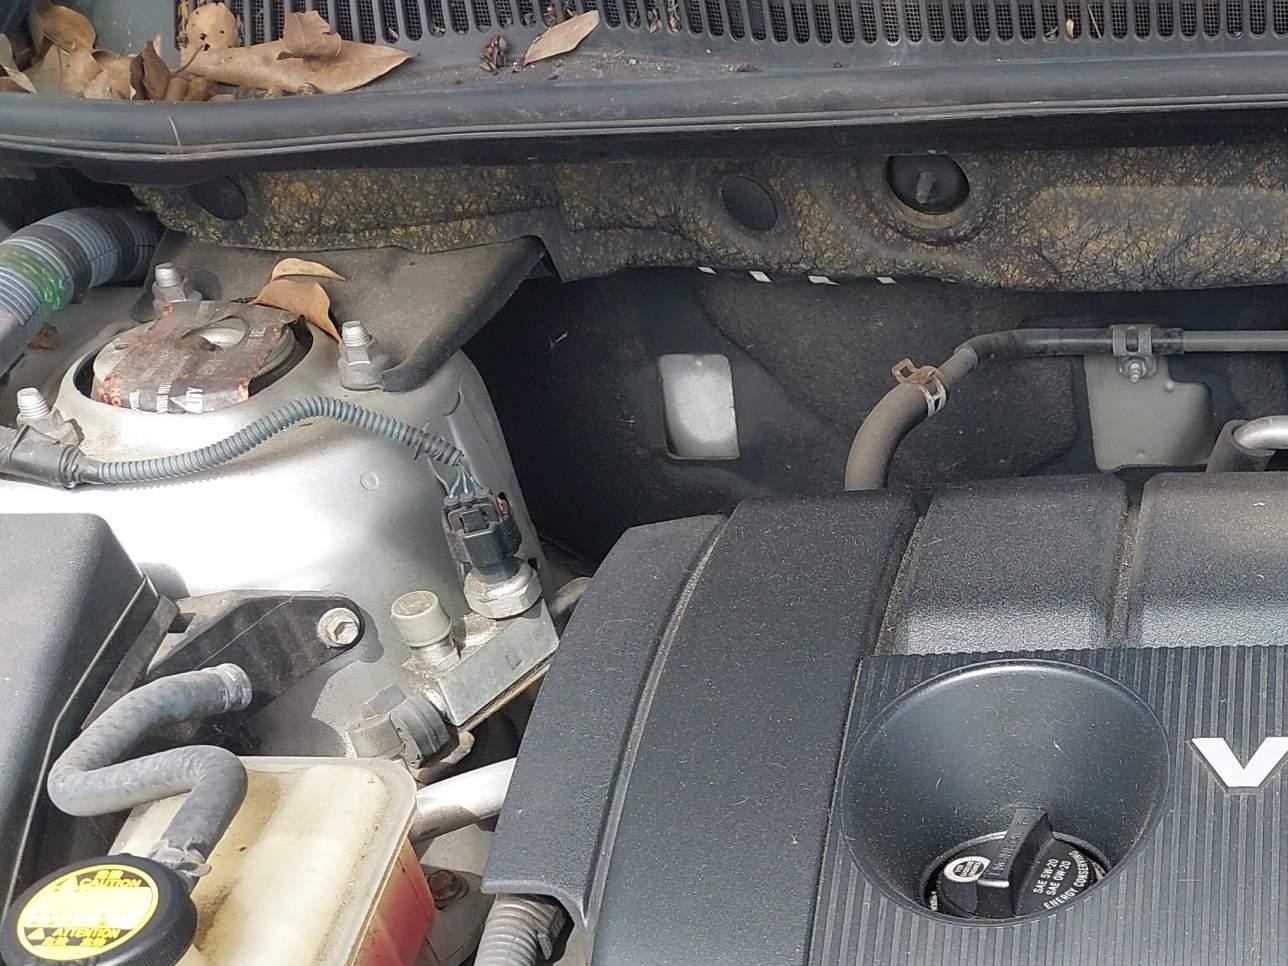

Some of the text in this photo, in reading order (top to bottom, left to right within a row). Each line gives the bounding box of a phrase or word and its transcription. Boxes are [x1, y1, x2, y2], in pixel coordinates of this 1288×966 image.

[79, 878, 142, 888] CAUTION
[1033, 859, 1059, 894] SAE 5W-20
[1043, 850, 1089, 909] ENERGY CONSERVING
[1046, 882, 1061, 895] SAE
[52, 927, 121, 938] ATTENTION
